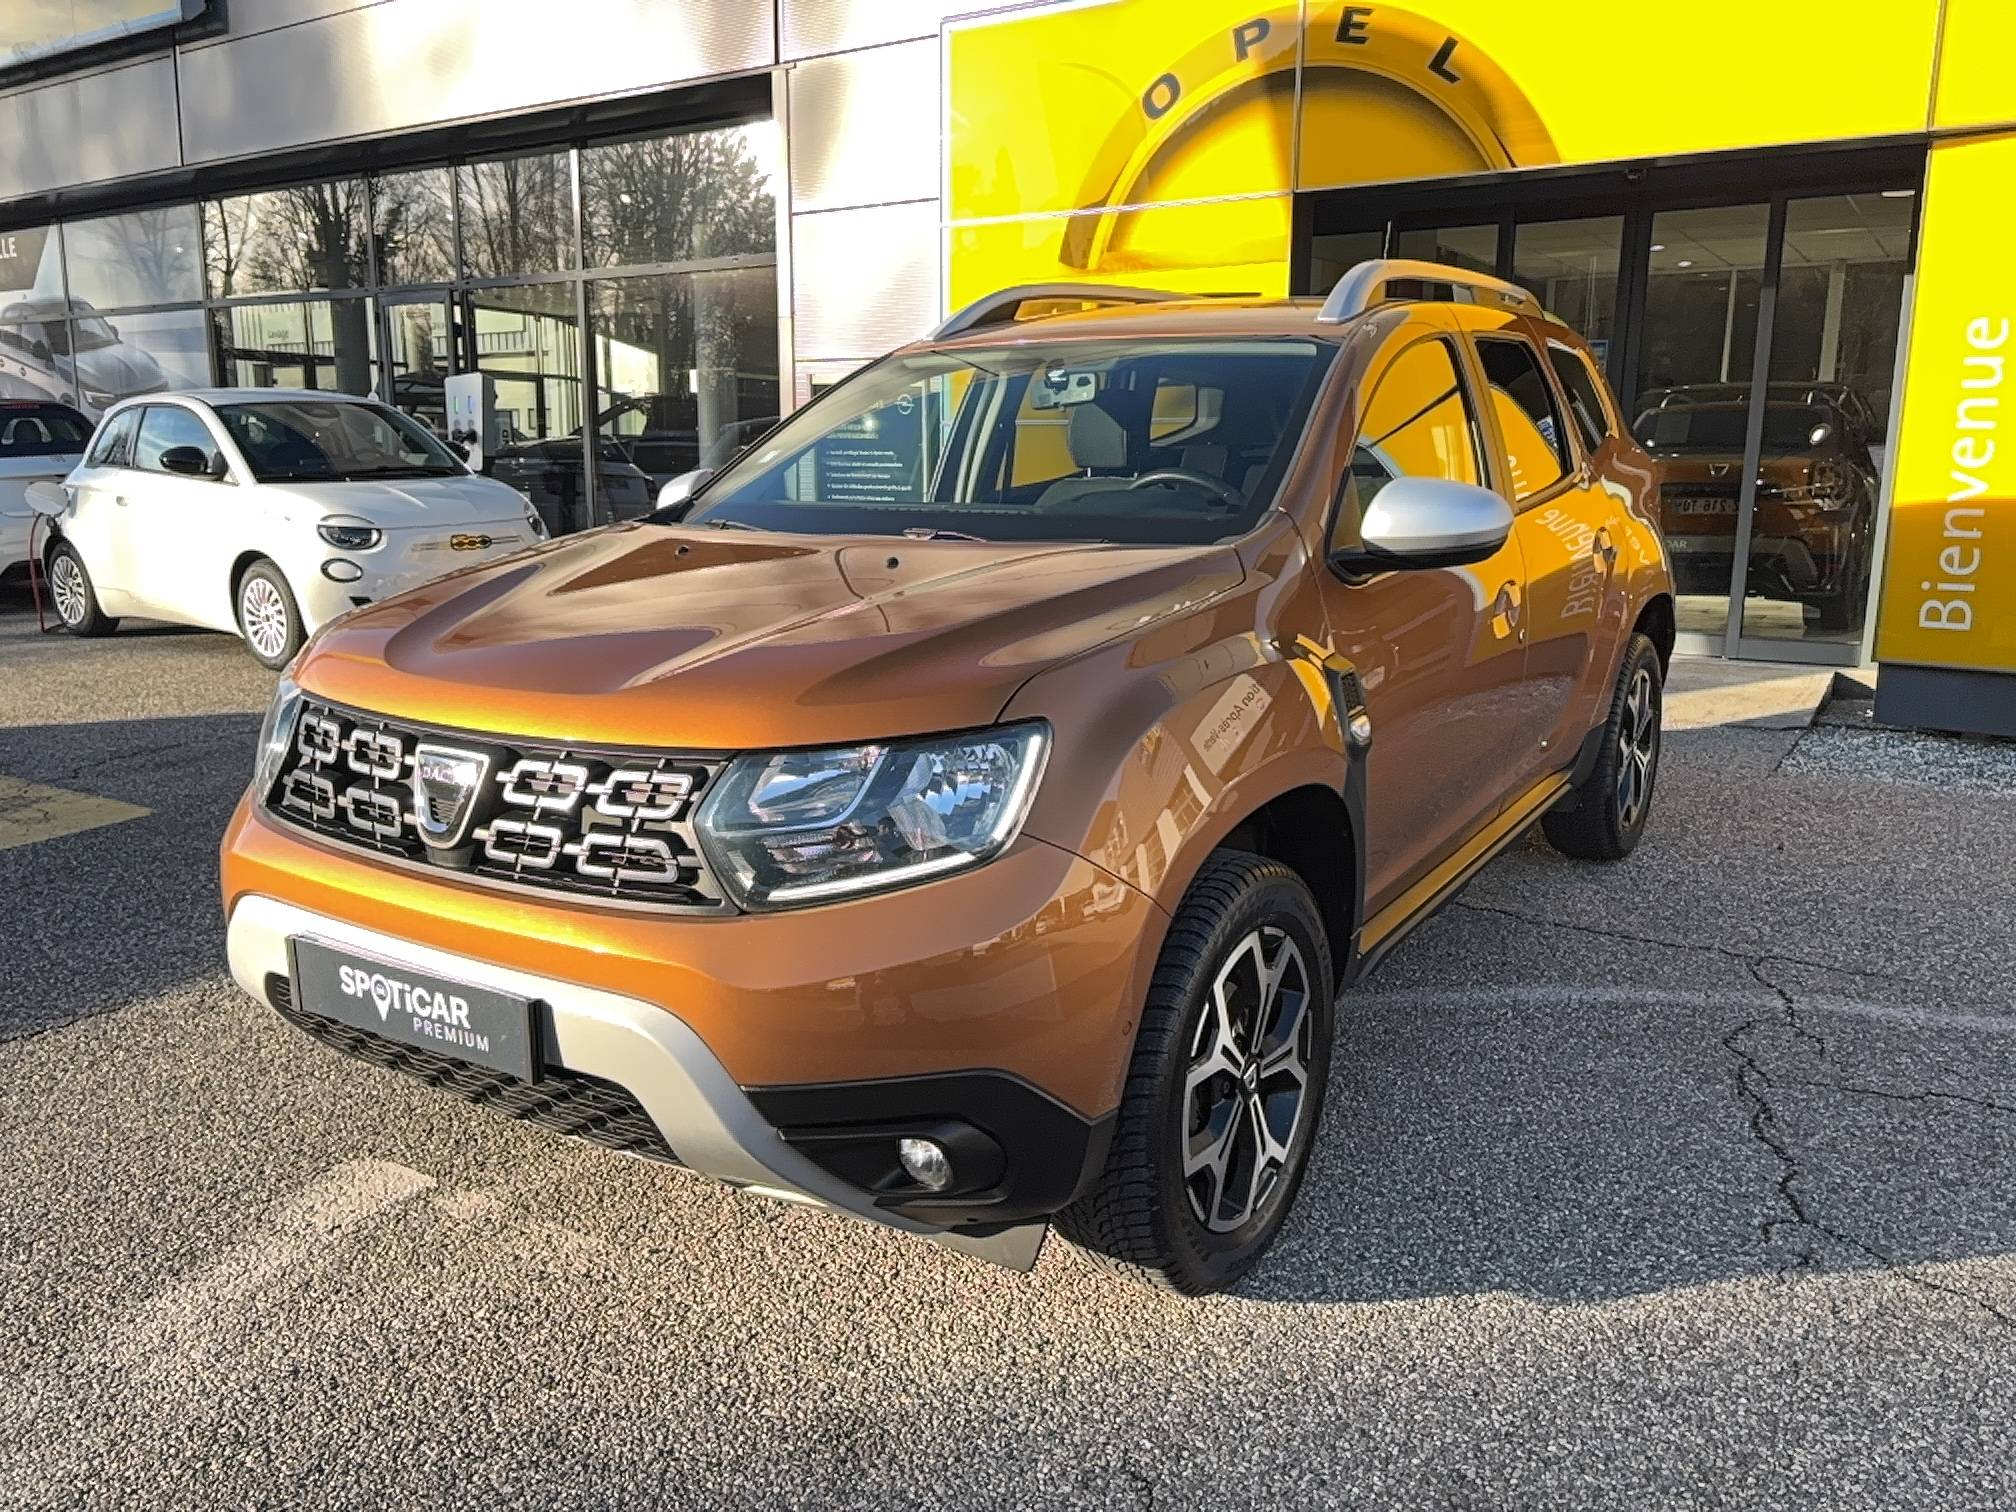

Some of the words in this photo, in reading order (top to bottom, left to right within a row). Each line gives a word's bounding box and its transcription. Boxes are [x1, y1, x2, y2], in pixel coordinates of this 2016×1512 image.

[1142, 6, 1462, 120] OPEL
[0, 237, 17, 259] LE
[1919, 315, 2010, 632] Bienvenue
[412, 1016, 490, 1054] PREMIUM
